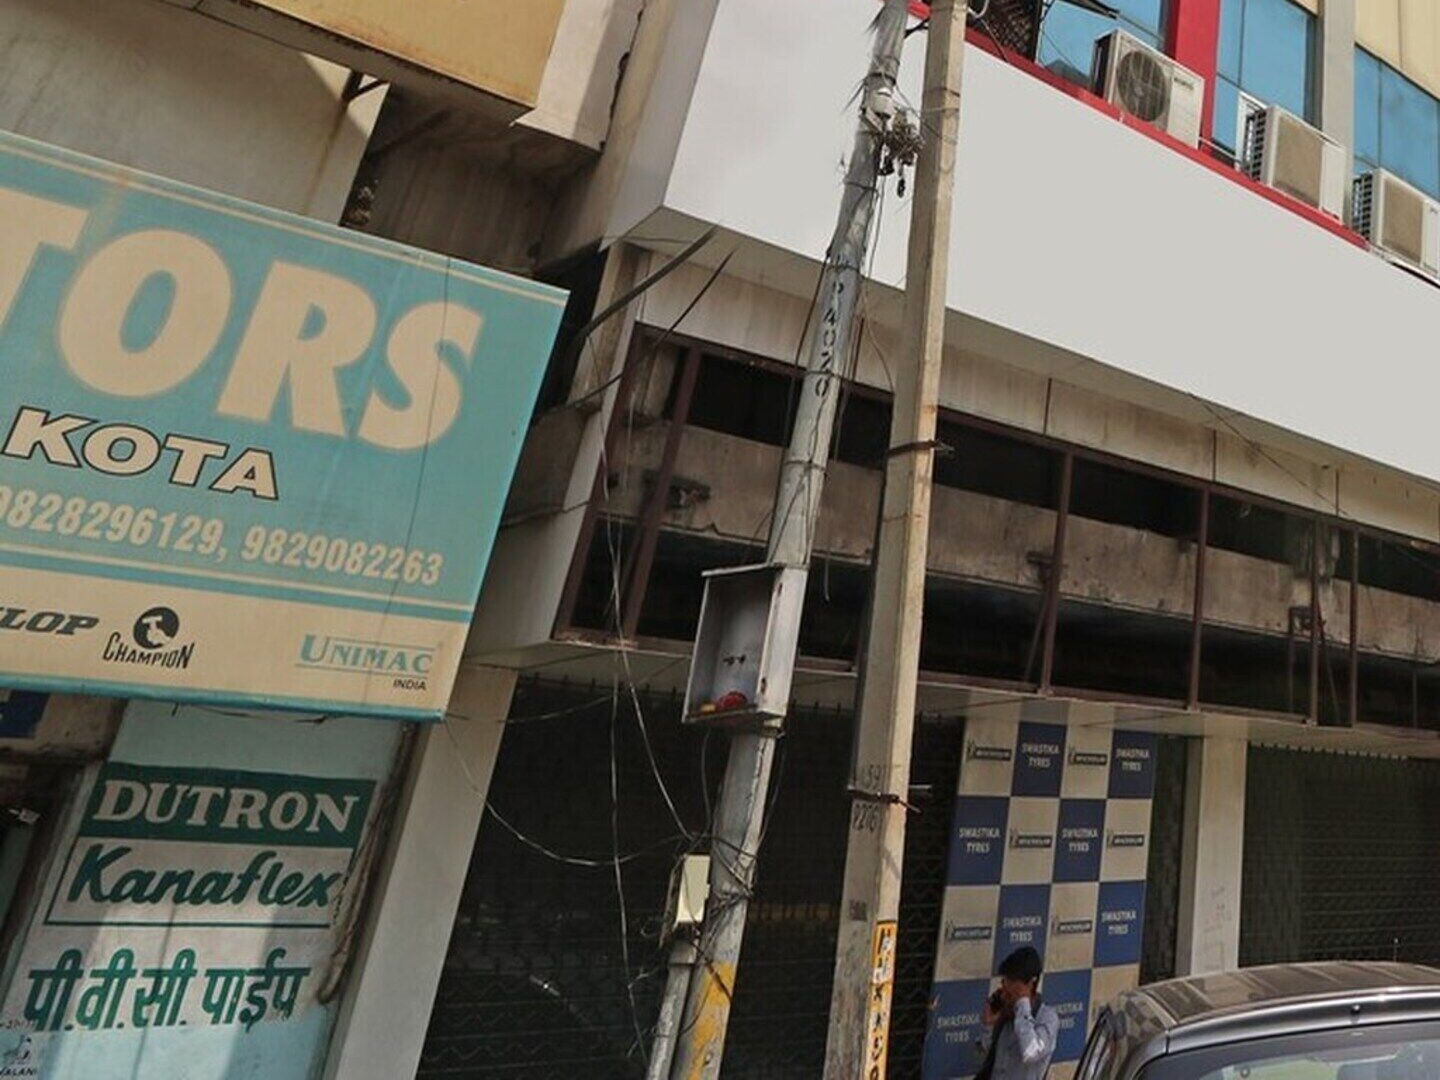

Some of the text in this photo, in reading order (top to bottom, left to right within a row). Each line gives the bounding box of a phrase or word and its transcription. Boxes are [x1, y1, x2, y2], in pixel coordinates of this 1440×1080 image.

[2, 406, 279, 500] KOTA
[241, 526, 443, 587] 9829082263
[0, 607, 99, 636] LOP
[103, 631, 195, 669] CHAMPION
[300, 633, 433, 674] UNIMAC
[393, 678, 427, 691] INDIA
[92, 779, 358, 833] DUTRON
[67, 844, 343, 908] Kanaflex
